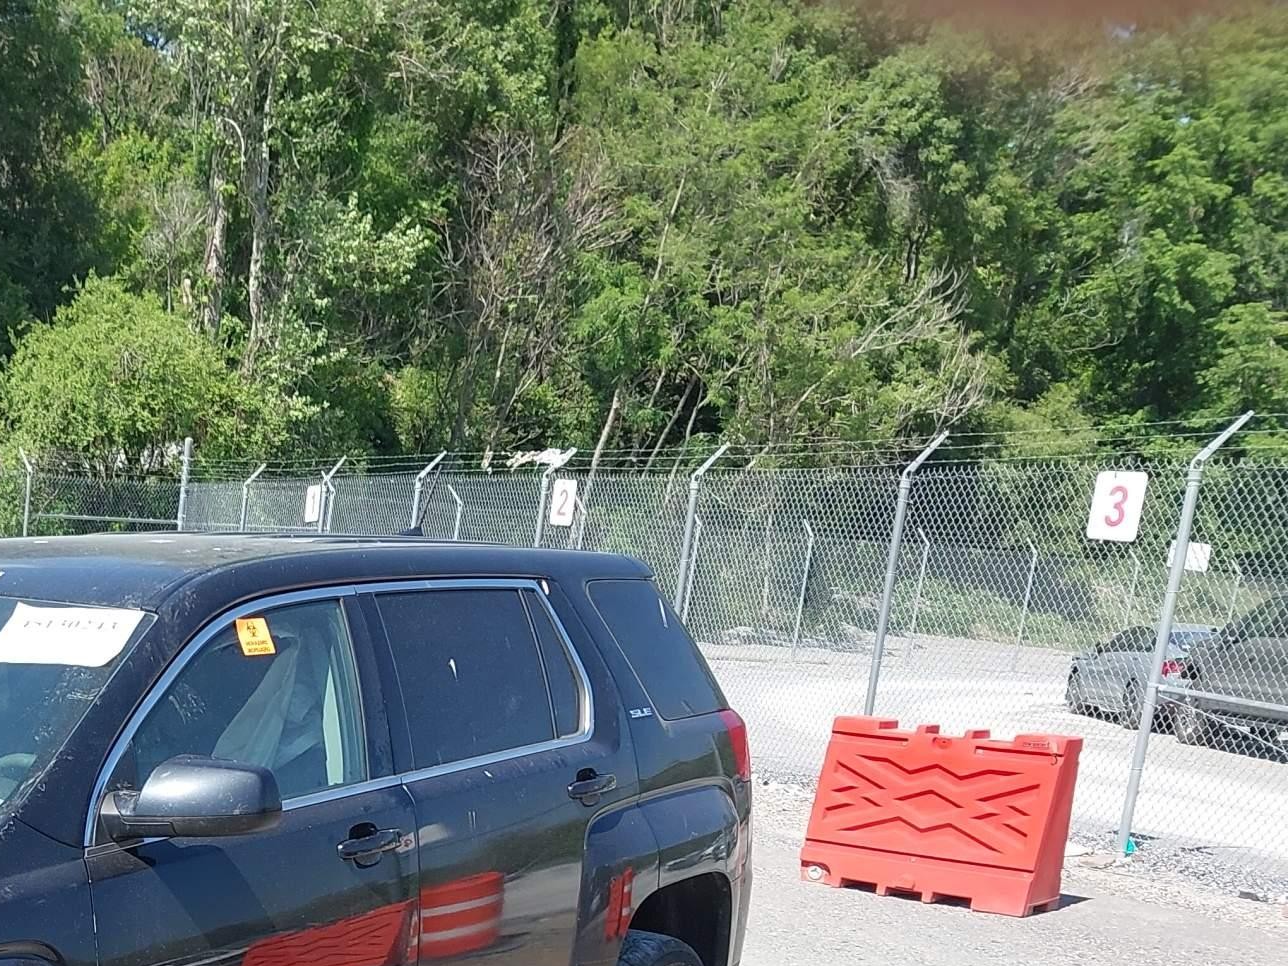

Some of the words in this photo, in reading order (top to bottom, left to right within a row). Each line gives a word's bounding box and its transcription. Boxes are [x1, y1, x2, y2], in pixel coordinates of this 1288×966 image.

[556, 489, 570, 517] 2
[1104, 485, 1129, 527] 3
[629, 706, 654, 719] SLE
